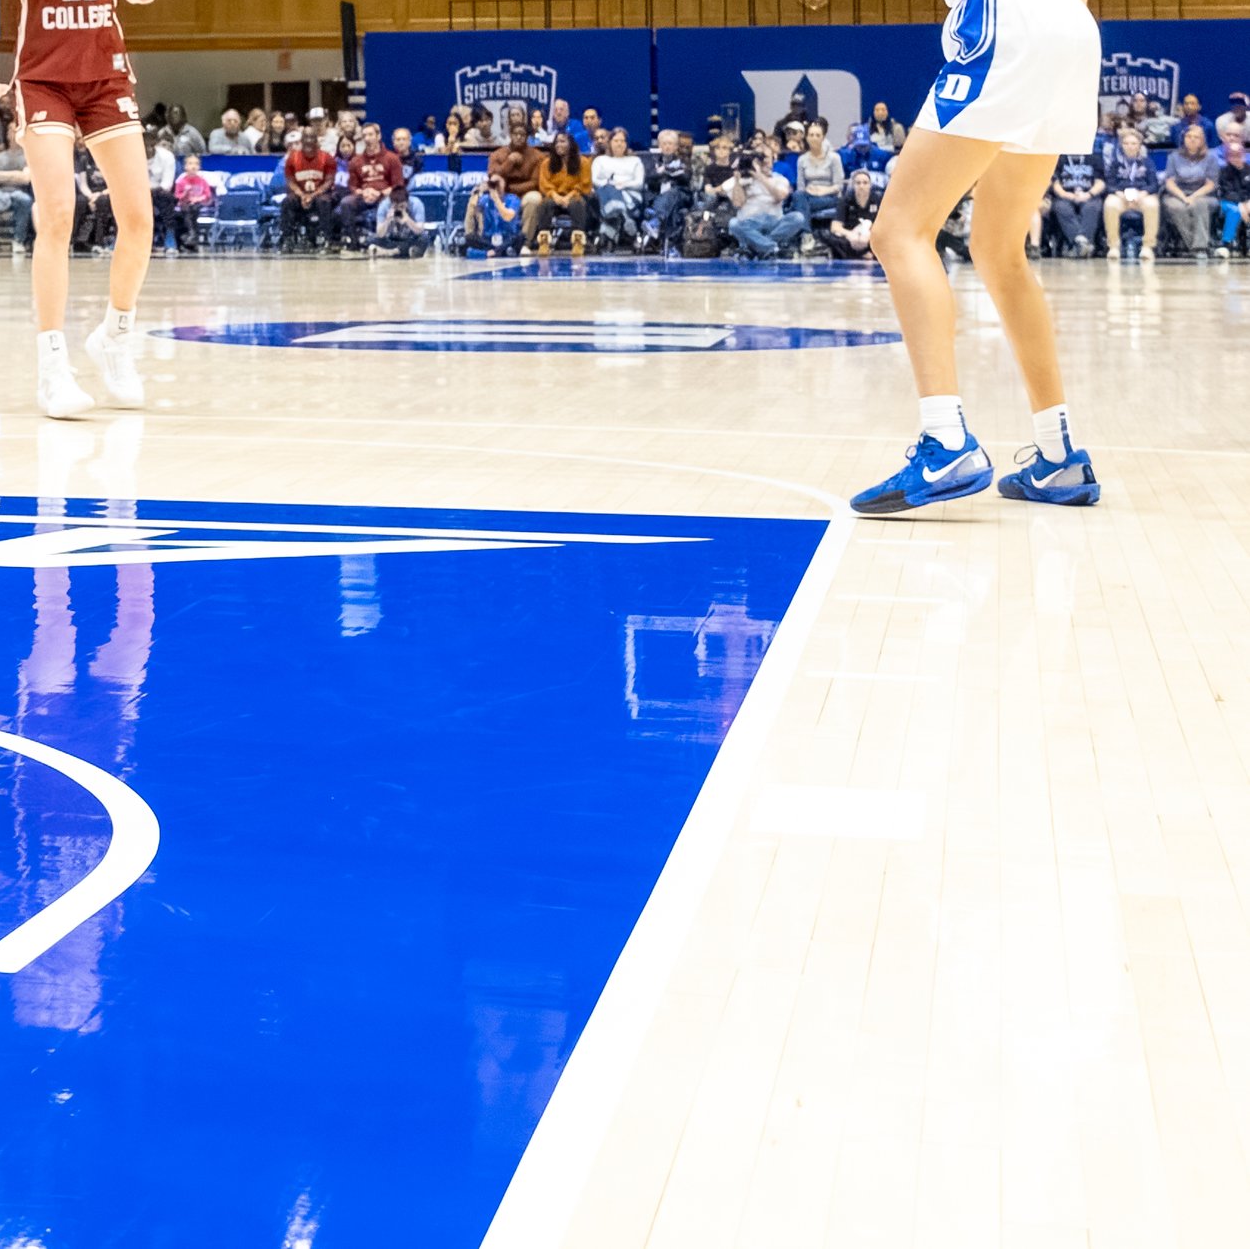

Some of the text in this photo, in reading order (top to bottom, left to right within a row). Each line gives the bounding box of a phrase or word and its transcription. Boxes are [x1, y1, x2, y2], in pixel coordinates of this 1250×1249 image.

[42, 4, 114, 30] COLLEGE
[464, 81, 548, 104] SISTERHOOD
[940, 74, 972, 100] D
[1102, 75, 1170, 100] TERHOOD
